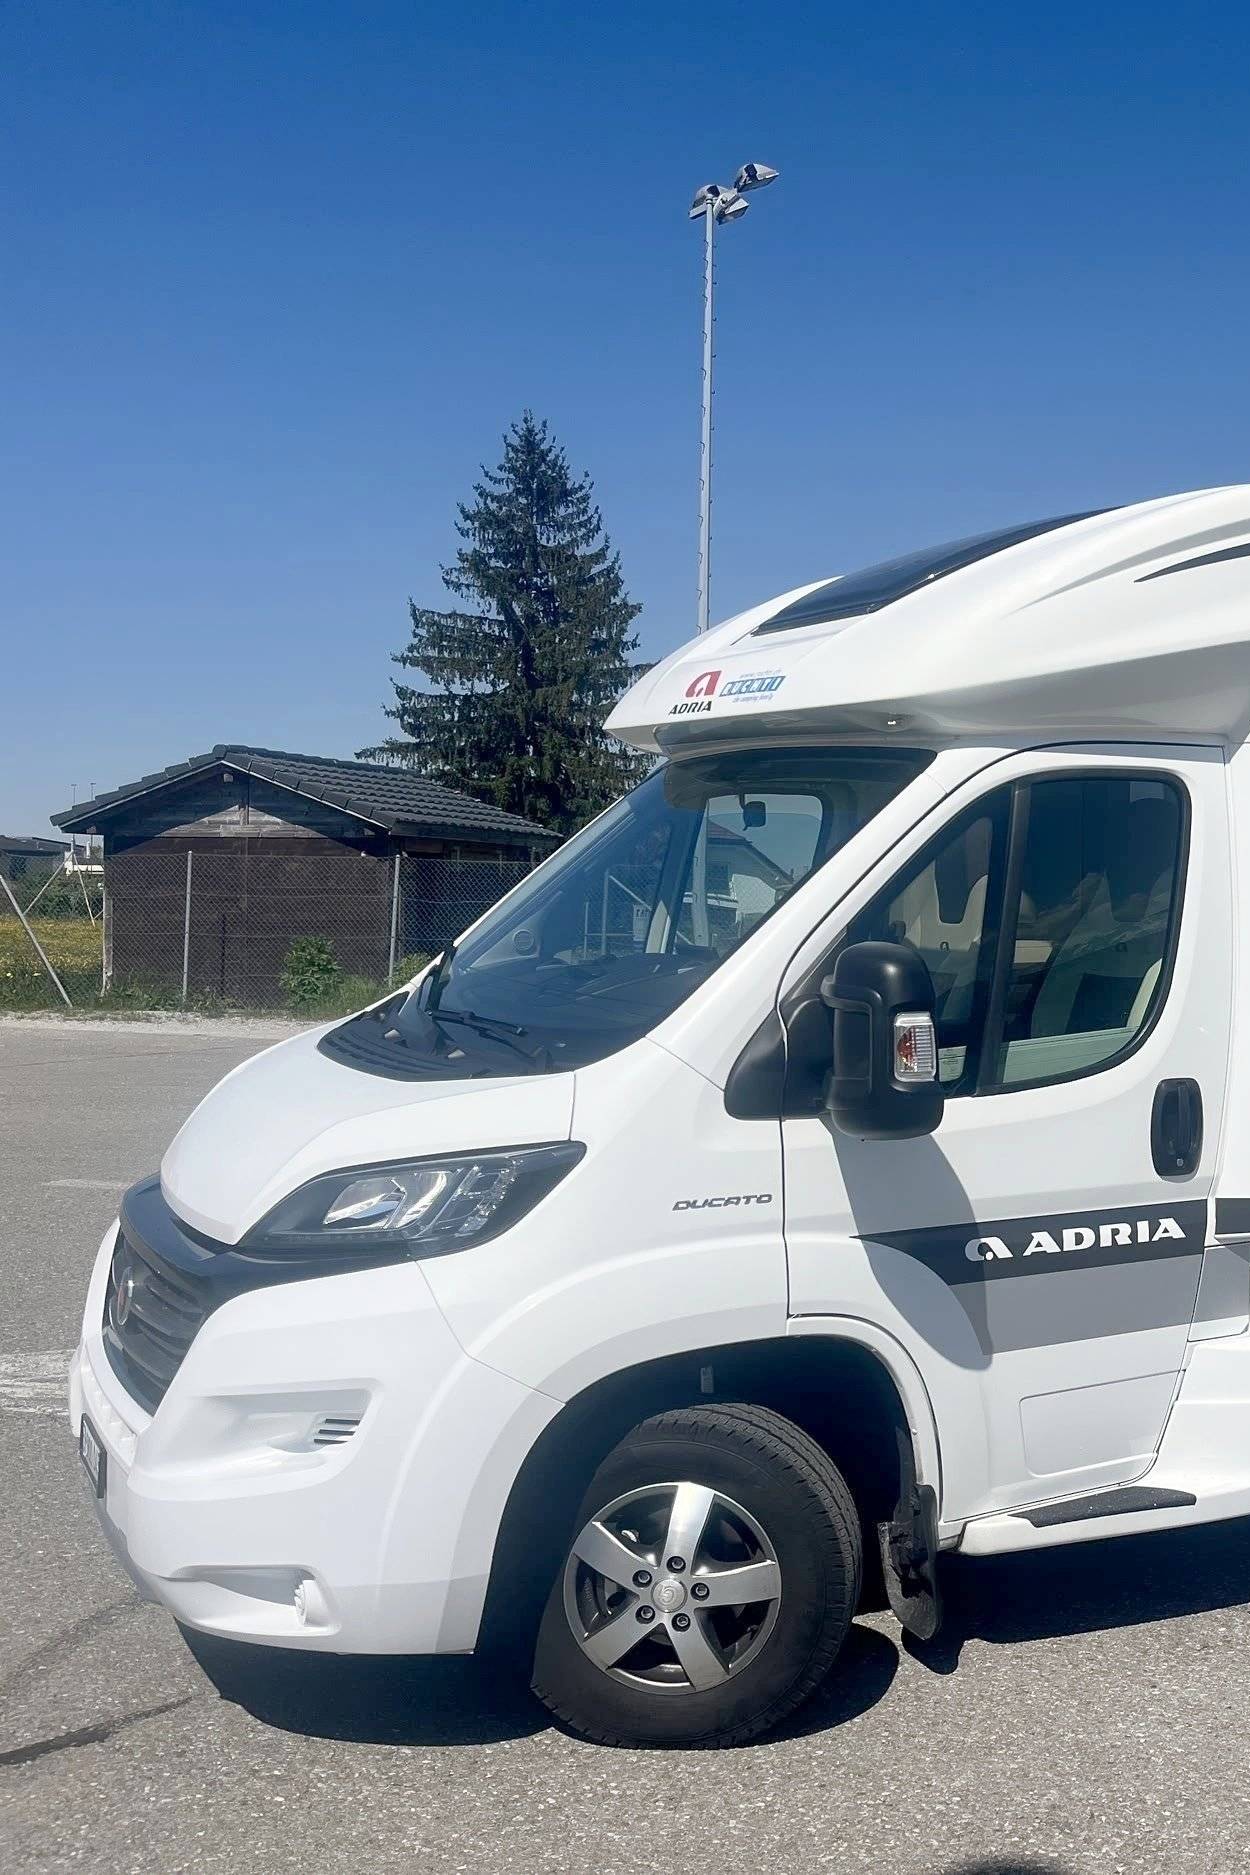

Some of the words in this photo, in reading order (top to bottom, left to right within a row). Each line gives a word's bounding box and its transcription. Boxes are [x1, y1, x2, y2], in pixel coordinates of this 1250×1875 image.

[669, 701, 712, 715] ADRIA
[672, 1194, 773, 1211] DUCATO
[1023, 1218, 1187, 1256] ADRIA
